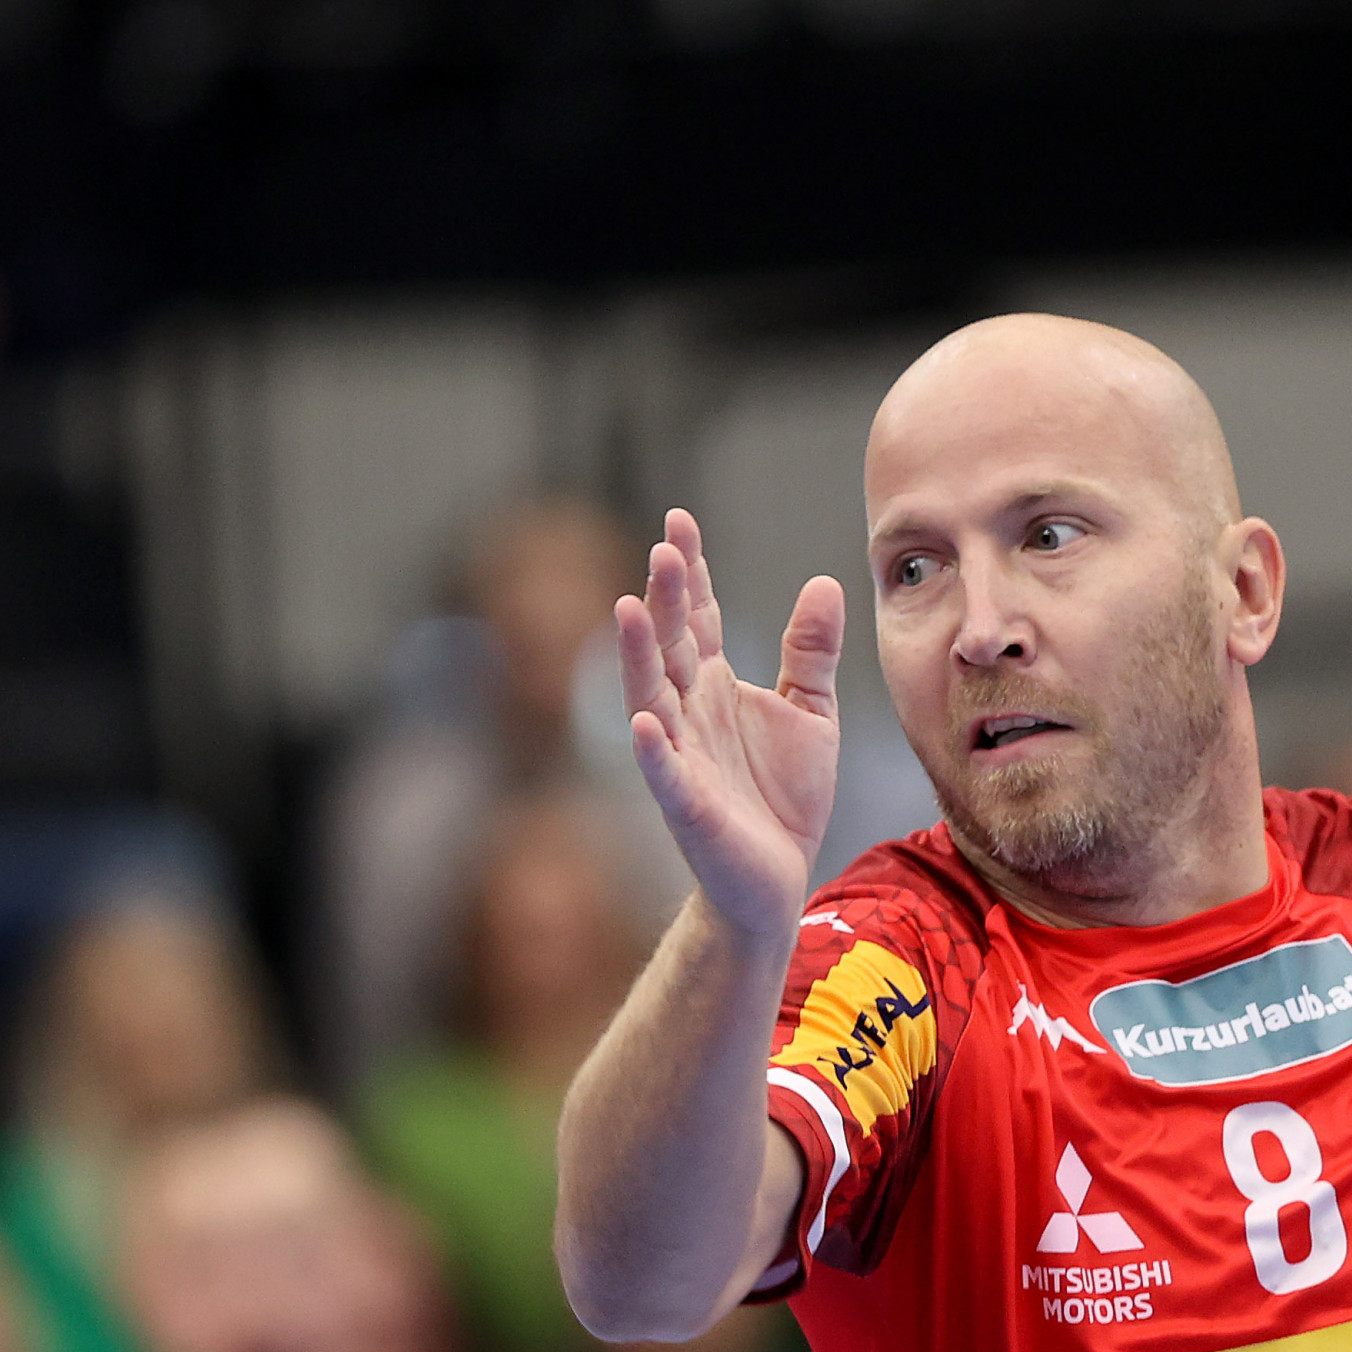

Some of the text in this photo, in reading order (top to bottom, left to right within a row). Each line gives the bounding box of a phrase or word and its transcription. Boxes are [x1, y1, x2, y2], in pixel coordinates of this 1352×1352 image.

[1221, 1101, 1347, 1296] 8
[1022, 1259, 1173, 1294] MITSUBISHI
[1043, 1292, 1154, 1325] MOTORS
